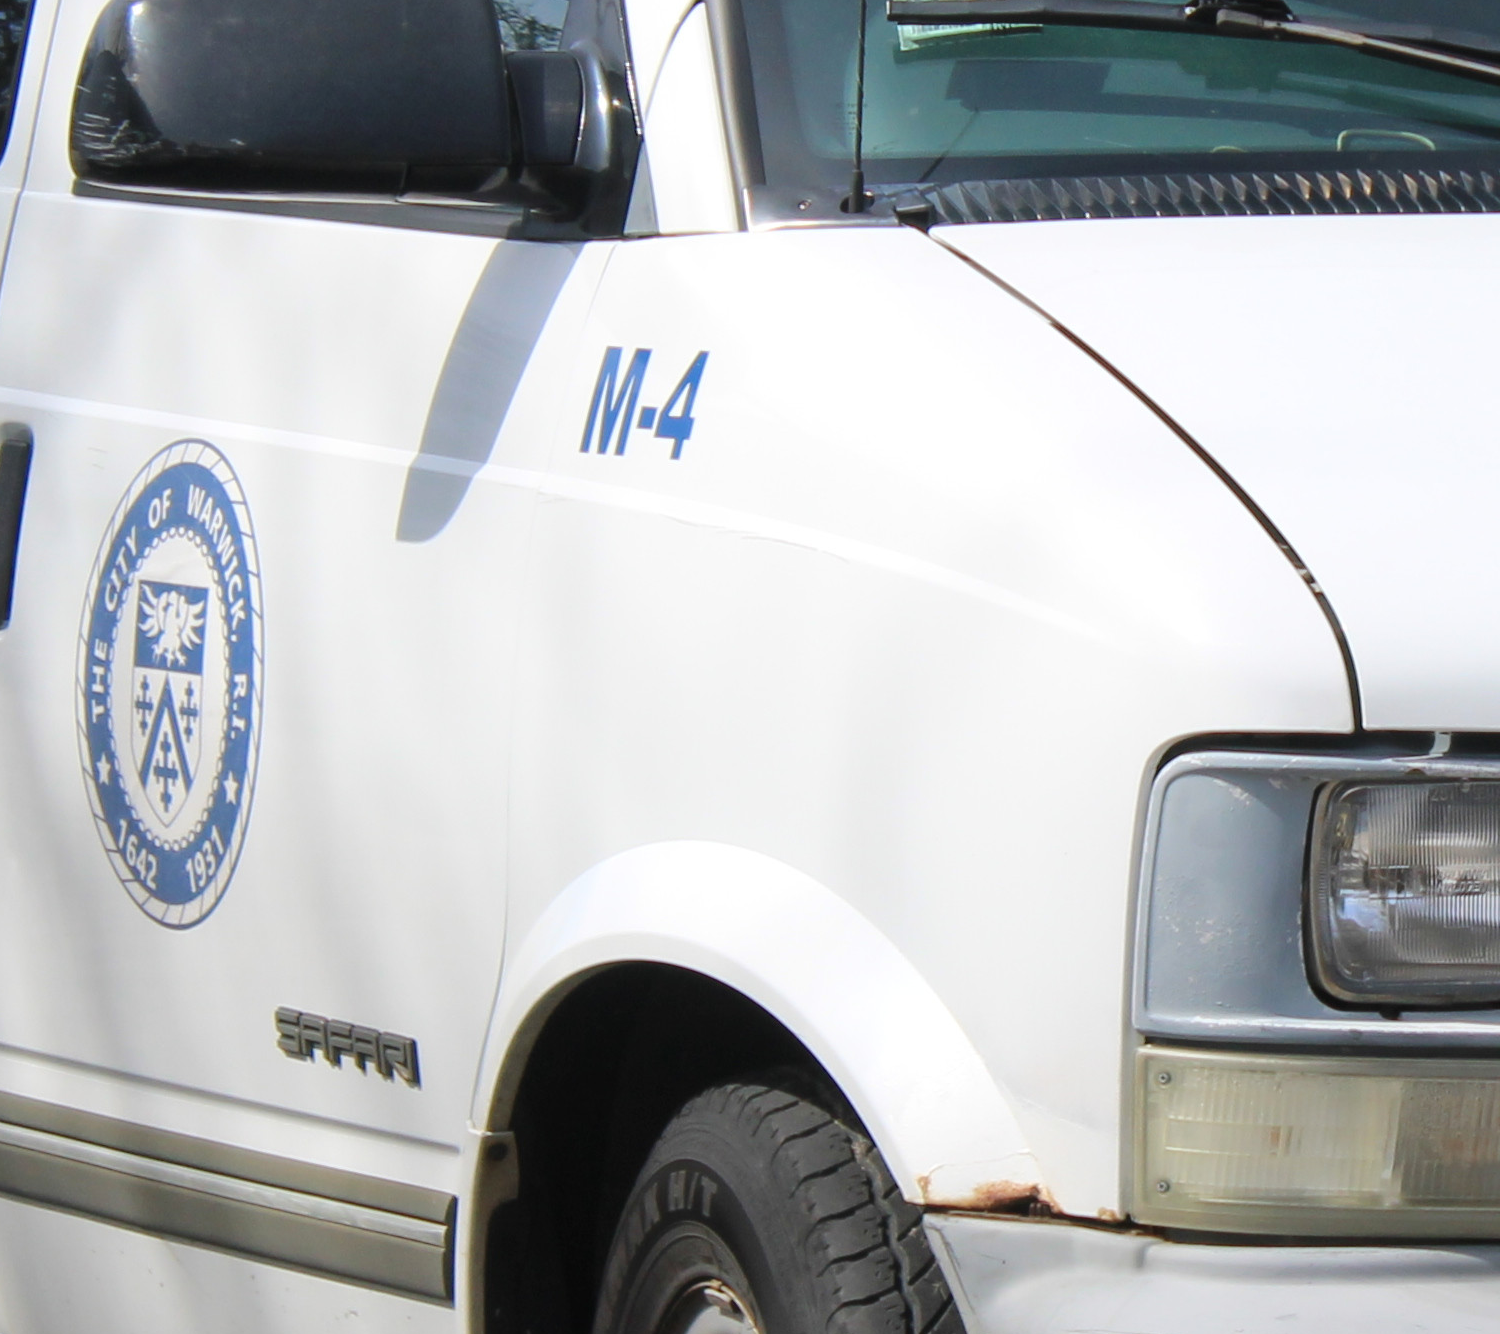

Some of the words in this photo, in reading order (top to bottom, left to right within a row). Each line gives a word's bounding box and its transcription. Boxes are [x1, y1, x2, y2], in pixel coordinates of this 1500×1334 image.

[579, 345, 710, 460] M-4
[91, 637, 109, 724] THE
[104, 525, 139, 612] CITY
[148, 487, 173, 529] OF
[230, 673, 248, 740] R.I.
[118, 818, 157, 891] 1642
[185, 824, 225, 894] 1931
[273, 1004, 422, 1091] SAFARI
